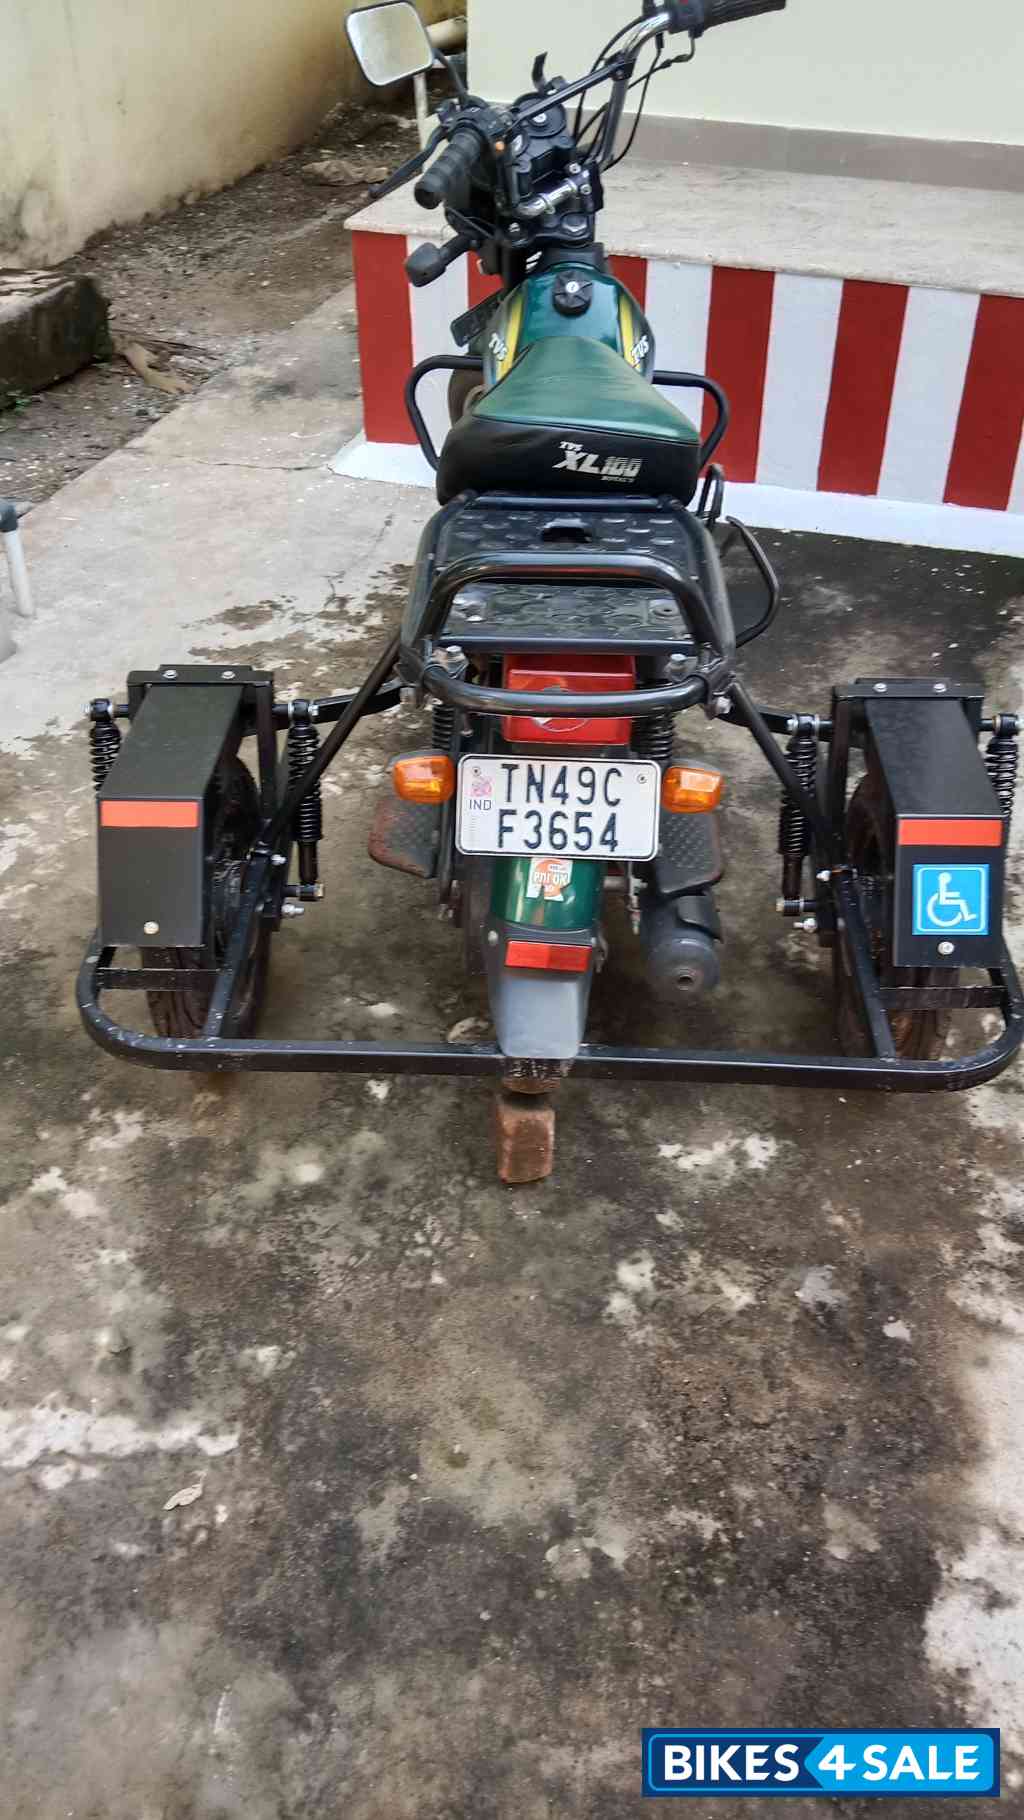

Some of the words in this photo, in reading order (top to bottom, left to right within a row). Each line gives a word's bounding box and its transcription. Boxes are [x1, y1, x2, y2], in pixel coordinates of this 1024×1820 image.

[488, 332, 509, 362] TVS
[632, 335, 650, 365] TVS
[558, 440, 584, 452] TVS
[500, 763, 623, 806] TN49C
[469, 798, 492, 811] IND
[497, 809, 619, 853] F3654
